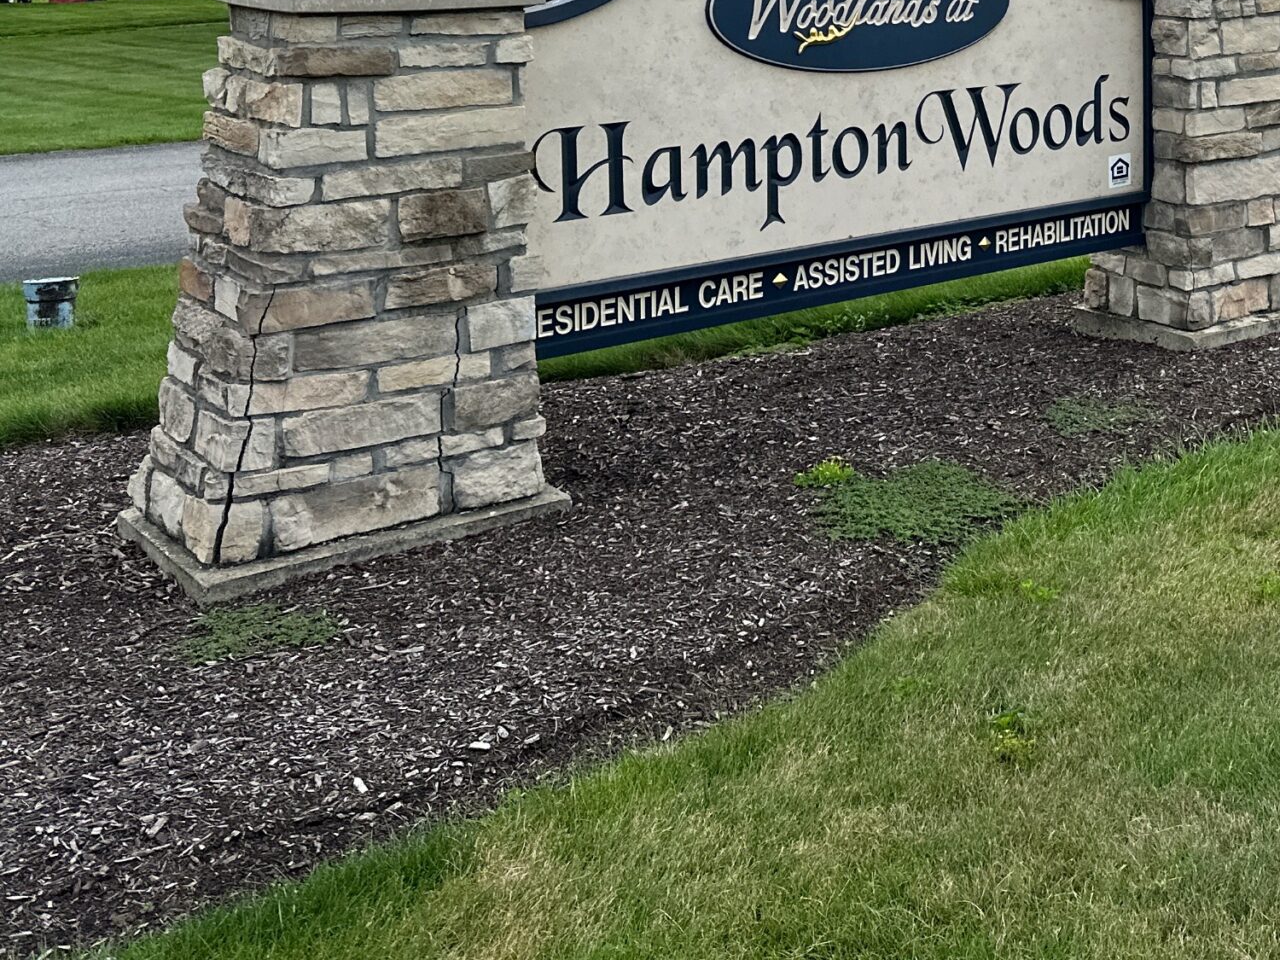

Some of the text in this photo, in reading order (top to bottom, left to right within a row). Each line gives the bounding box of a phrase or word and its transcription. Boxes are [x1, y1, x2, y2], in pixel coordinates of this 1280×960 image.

[531, 74, 1131, 232] Hampton Woods
[536, 208, 1130, 338] ESIDENTIAL CARE ASSISTED LIVING REHABILITATION
